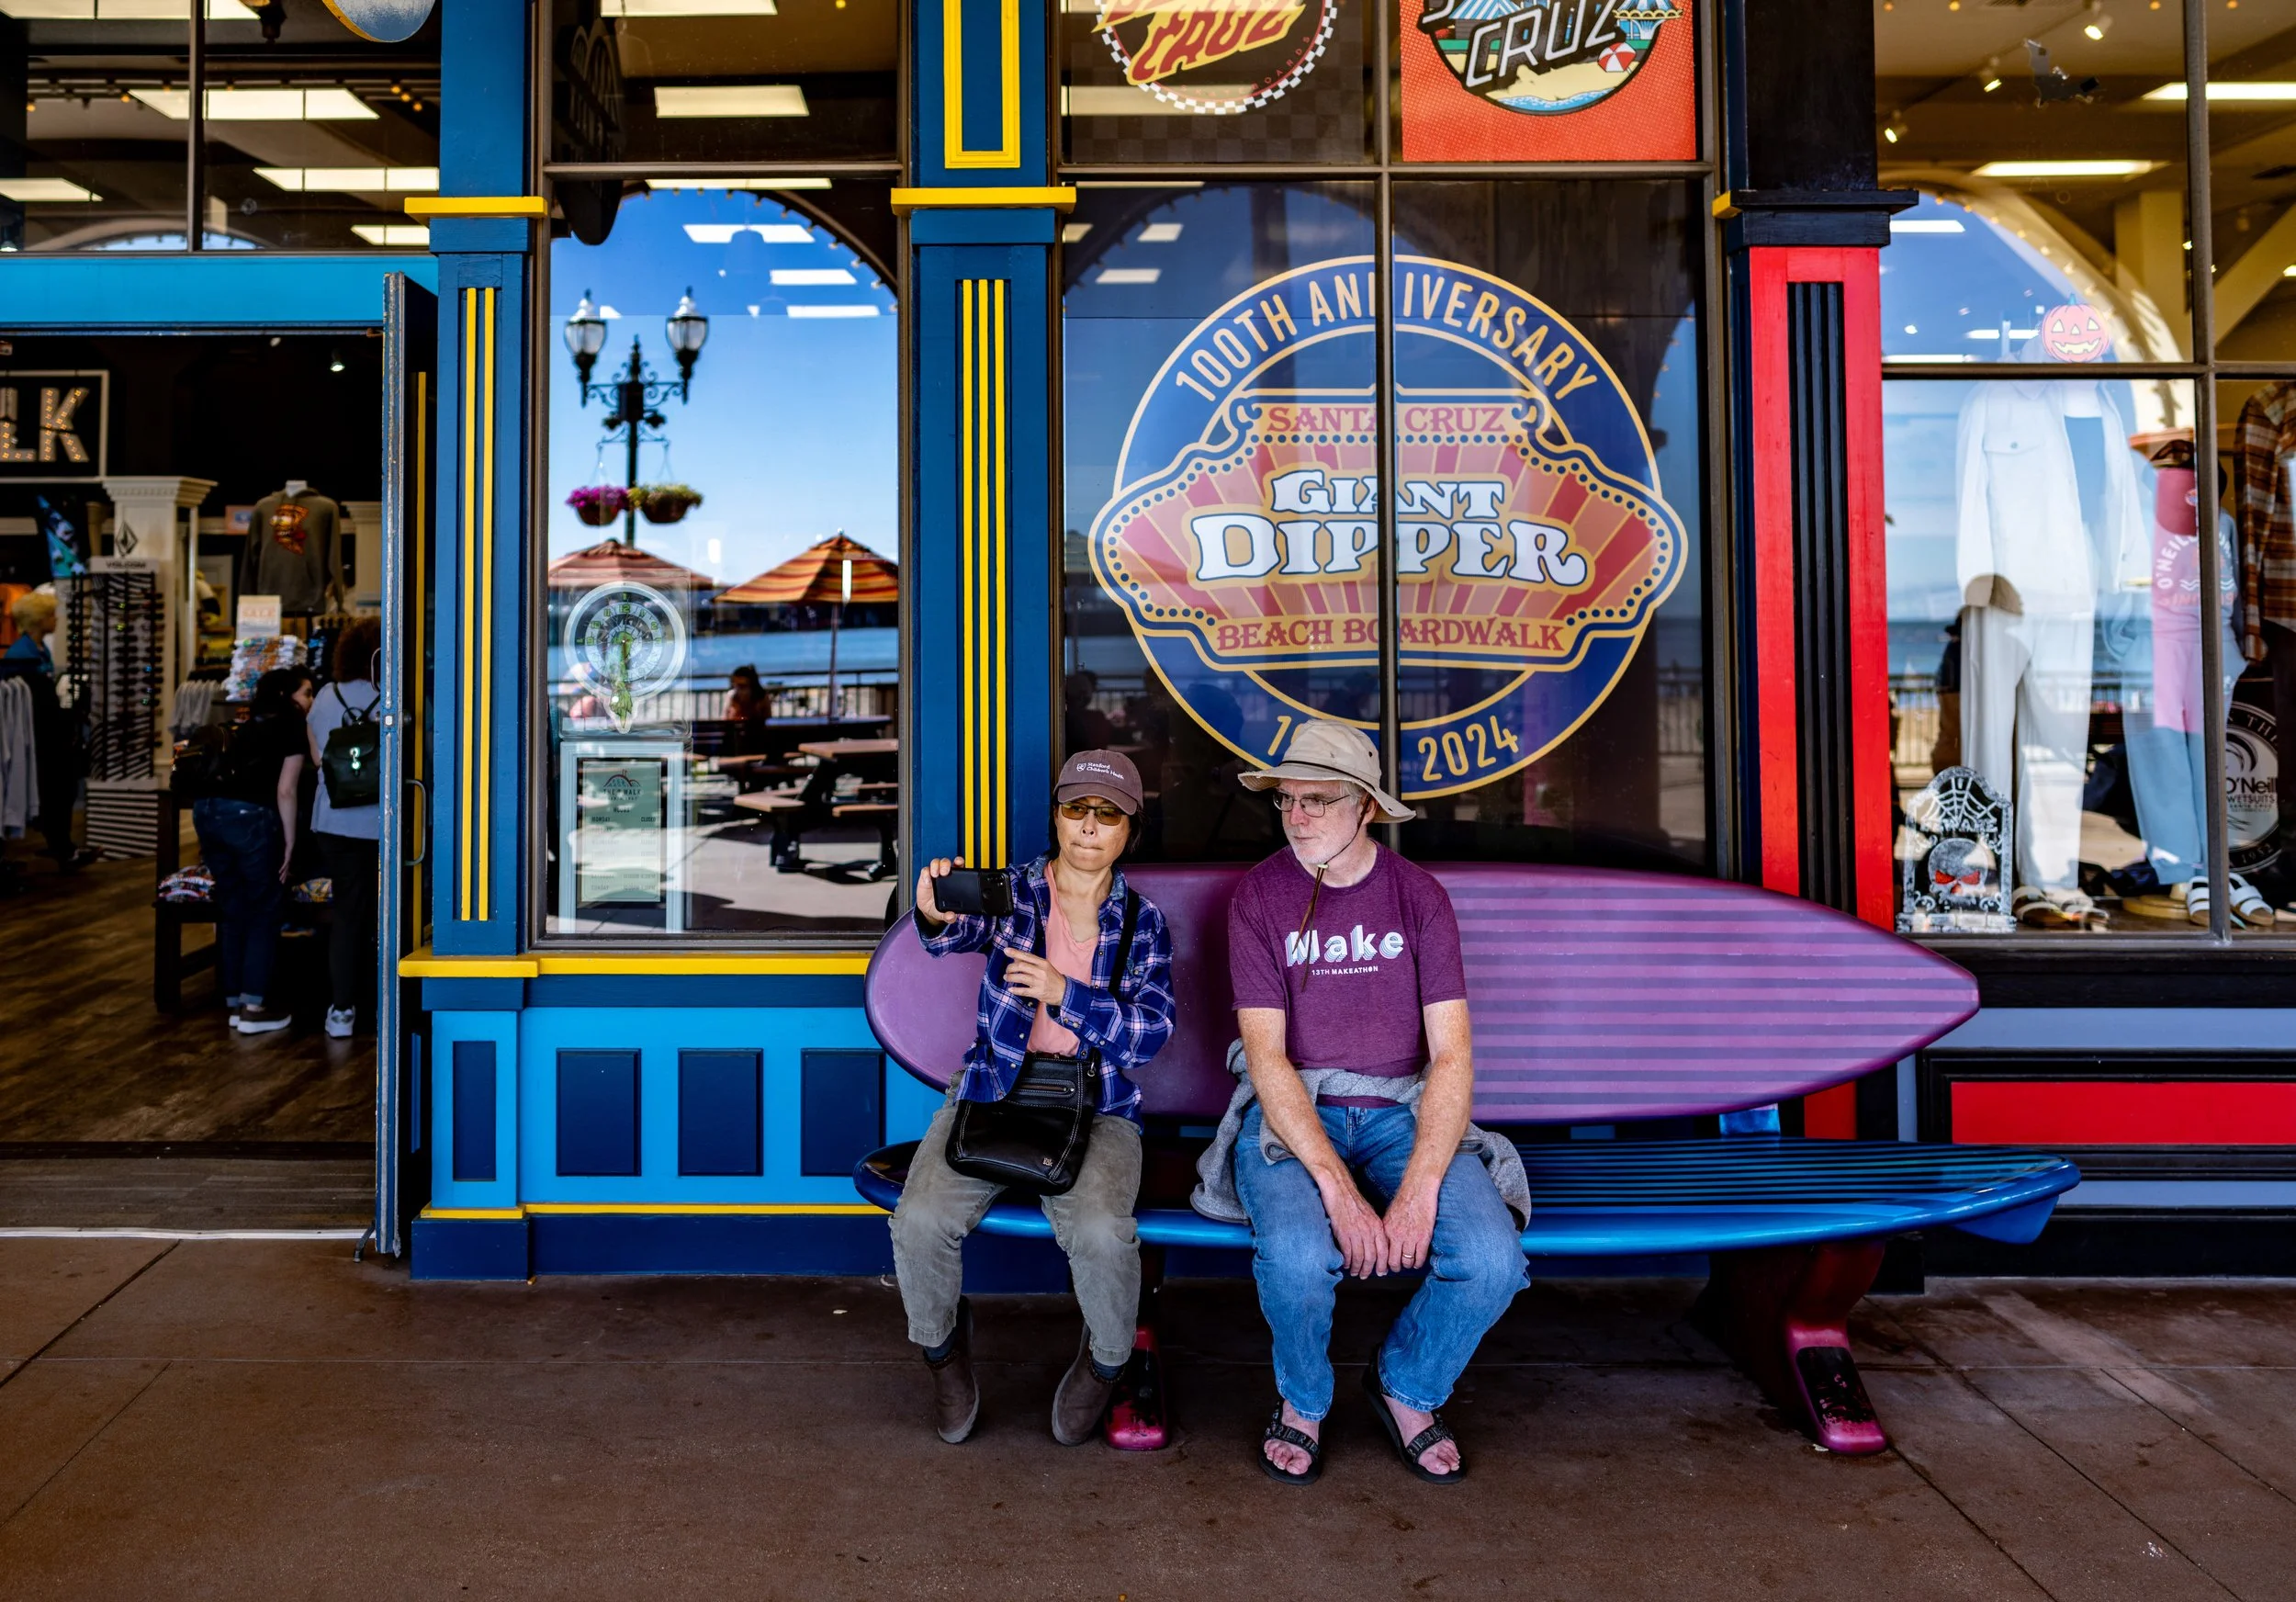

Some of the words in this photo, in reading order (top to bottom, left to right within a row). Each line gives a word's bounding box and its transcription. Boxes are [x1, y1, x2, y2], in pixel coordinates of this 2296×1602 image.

[1466, 0, 1616, 87] CRUZ
[1176, 294, 1298, 401] 100TH
[1309, 271, 1598, 400] ANIVERSARY
[1404, 406, 1506, 434] CRUZ
[1271, 469, 1505, 520] GIANT
[1190, 513, 1588, 587] DIPPER
[1217, 619, 1334, 650] BEACH
[1418, 715, 1519, 781] 2024
[1284, 924, 1404, 967] Make
[1331, 965, 1379, 976] MAKEATHON
